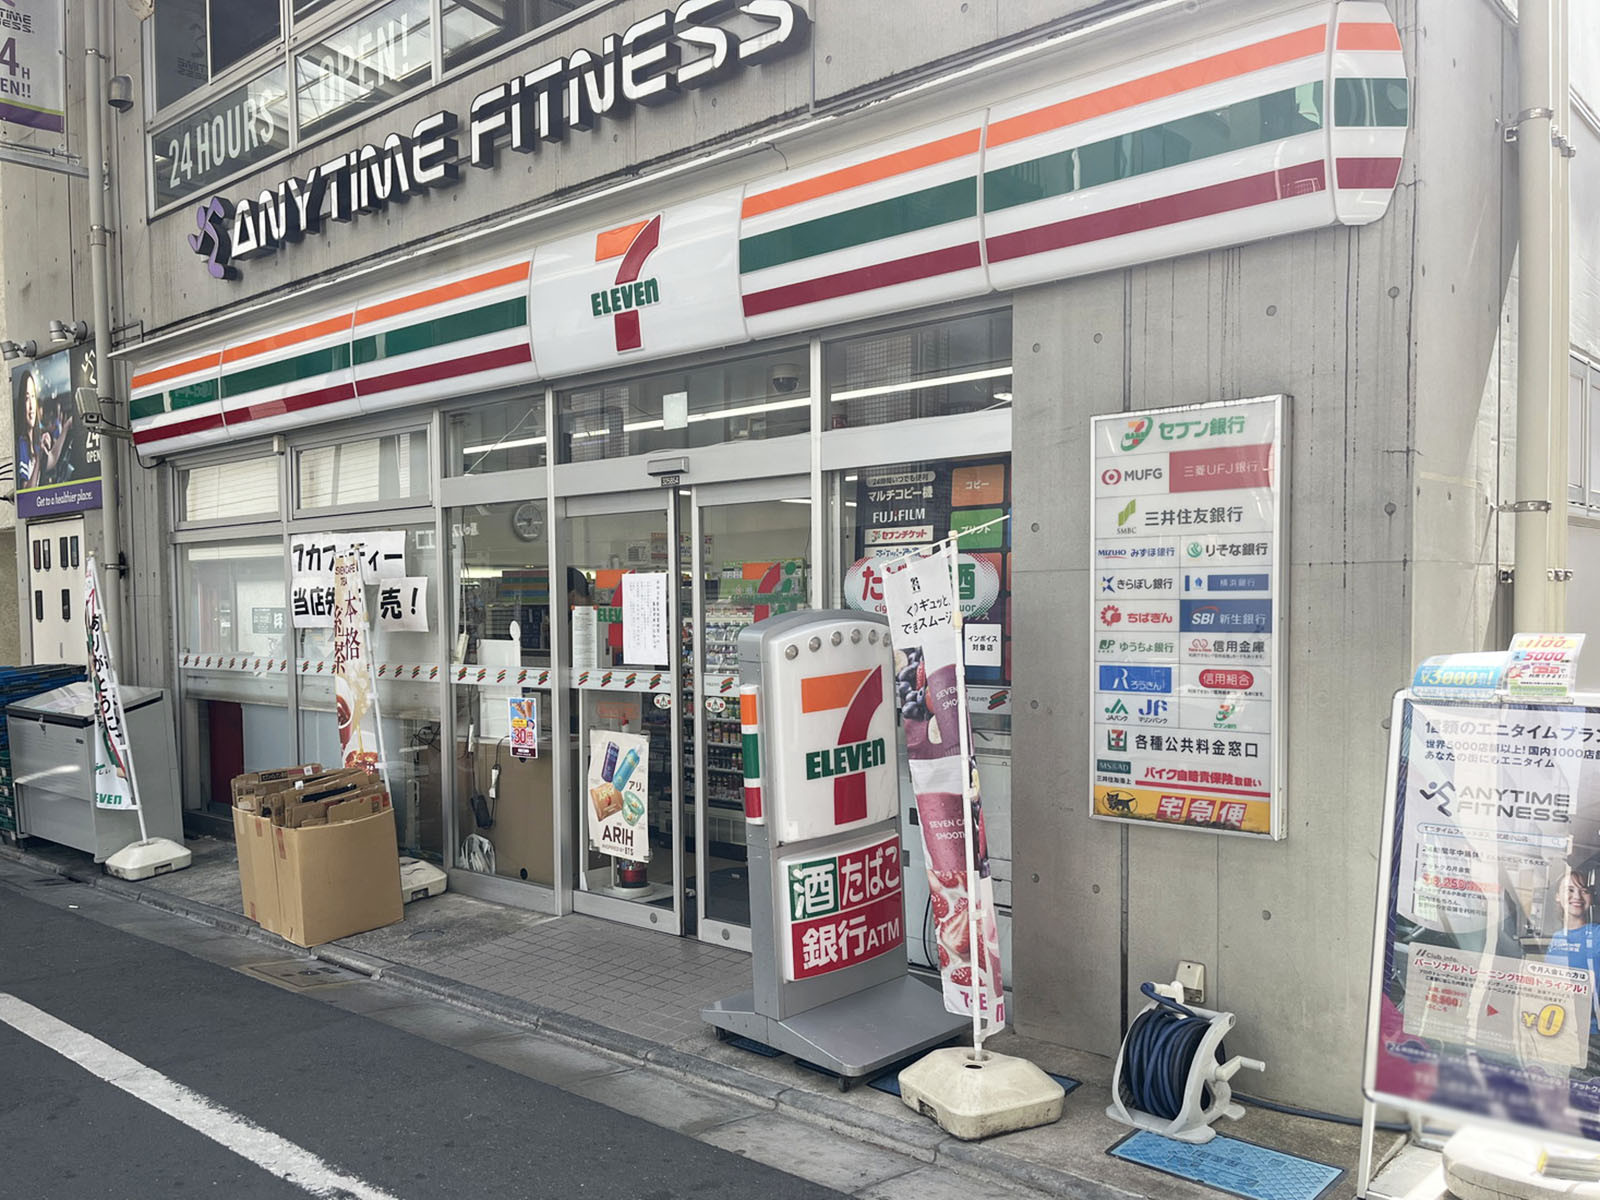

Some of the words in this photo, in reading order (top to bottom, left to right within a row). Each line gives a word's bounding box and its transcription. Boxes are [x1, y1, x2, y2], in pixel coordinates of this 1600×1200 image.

[22, 66, 31, 80] H
[231, 110, 449, 260] ANYTIME
[471, 0, 796, 167] FITNESS
[169, 131, 193, 189] 24
[196, 89, 275, 175] HOURS
[1158, 415, 1246, 441] セブン銀行
[1124, 467, 1163, 482] MUFG
[1183, 460, 1260, 478] 三菱UFJ銀行
[965, 480, 990, 490] コピー
[868, 485, 934, 502] マルチコピー機
[1144, 506, 1244, 527] 三井住友銀行
[882, 529, 928, 541] セブンチケット
[1116, 526, 1137, 534] SMBC
[1130, 547, 1175, 557] みずほ銀行
[1205, 542, 1269, 557] りそな銀行
[1117, 578, 1173, 590] きらぼし銀行
[1220, 578, 1256, 587] 横浜銀行
[1127, 612, 1173, 624] ちばぎん
[1191, 612, 1214, 625] SBI
[1220, 613, 1266, 626] 新生銀行
[1120, 641, 1175, 653] ゆうちょ銀行
[1213, 640, 1265, 653] 信用金庫
[1130, 680, 1162, 691] ろうきん
[1203, 673, 1250, 686] 信用組合
[1138, 716, 1168, 724] マリンバンク
[1135, 734, 1259, 758] 各種公共料金窓口
[1097, 775, 1131, 785] 三井住友海上
[1144, 766, 1262, 788] バイク自賠責保険取扱い
[1459, 785, 1570, 808] ANYTIME
[1159, 795, 1247, 828] 宅急便
[1457, 801, 1569, 824] FITNESS
[602, 825, 634, 847] ARIH
[841, 846, 900, 907] たばこ
[793, 863, 835, 919] 酒
[802, 916, 901, 970] 銀行ATM
[1522, 1003, 1567, 1037] ¥0
